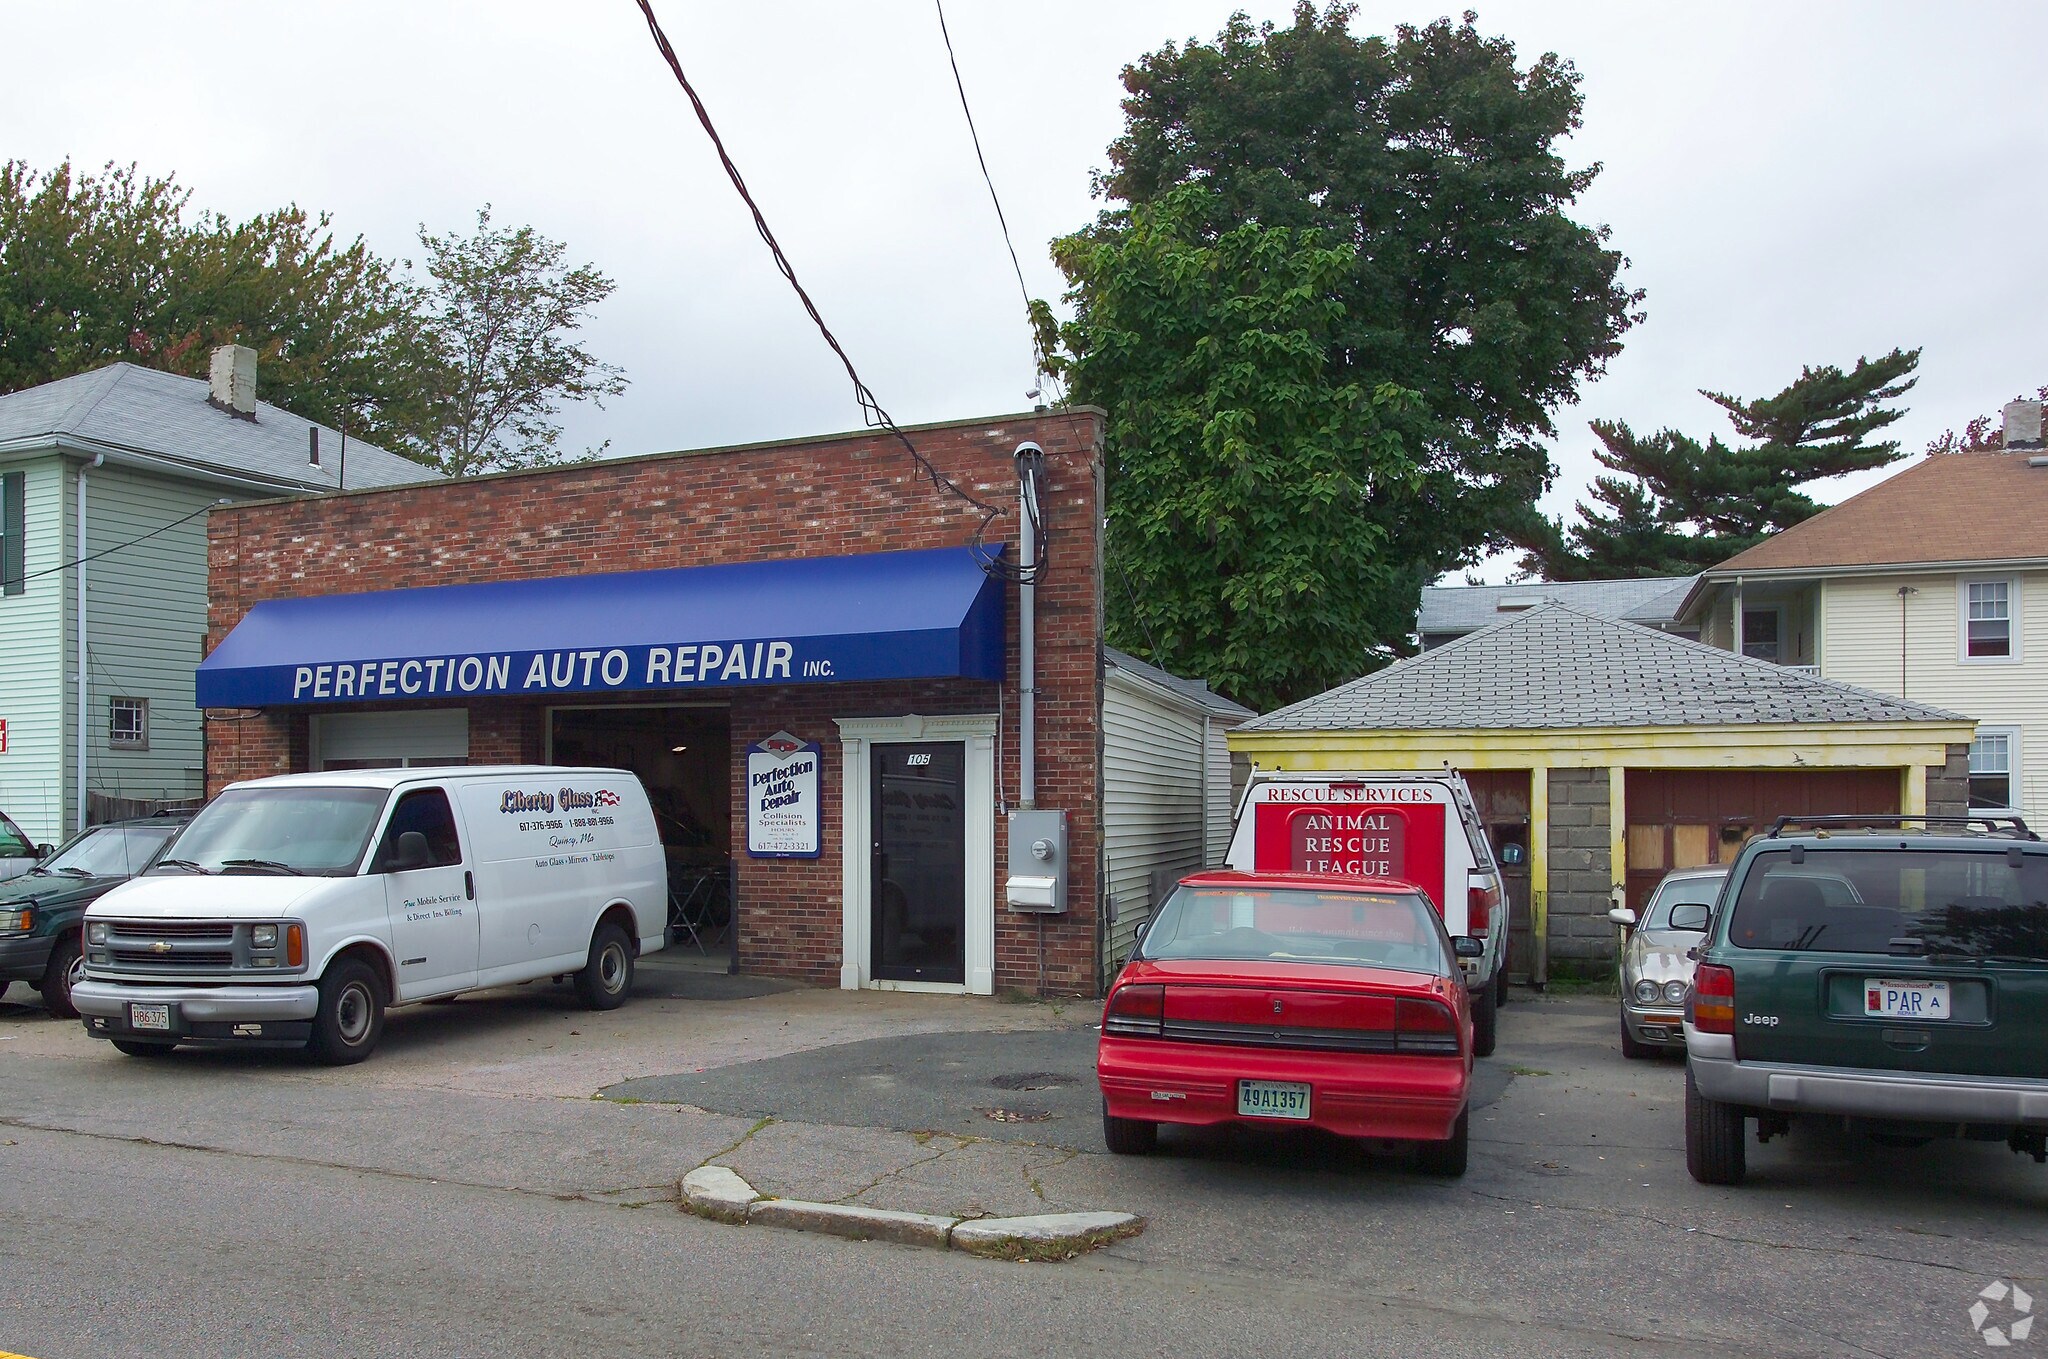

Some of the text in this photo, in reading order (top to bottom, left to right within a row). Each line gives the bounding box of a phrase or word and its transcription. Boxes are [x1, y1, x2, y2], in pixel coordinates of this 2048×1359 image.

[293, 641, 834, 699] PERFECTION AUTO REPAIR INC.
[909, 754, 929, 764] 105
[753, 761, 813, 787] Perfection
[764, 779, 795, 798] Auto
[1268, 788, 1433, 802] RESCUE SERVICES
[499, 787, 593, 814] Liberty Glass
[760, 790, 801, 812] Repair
[759, 819, 807, 827] Specialists
[763, 812, 803, 820] Collision
[1305, 815, 1390, 830] ANIMAL
[519, 819, 563, 831] 617-376-9966
[758, 841, 809, 850] 617-472-3321
[1305, 837, 1390, 853] RESCUE
[417, 896, 437, 906] Mobile
[438, 894, 461, 902] Service
[1887, 990, 1940, 1012] PAR A
[1743, 1013, 1779, 1027] Jeep
[1243, 1089, 1306, 1109] 49A1357
